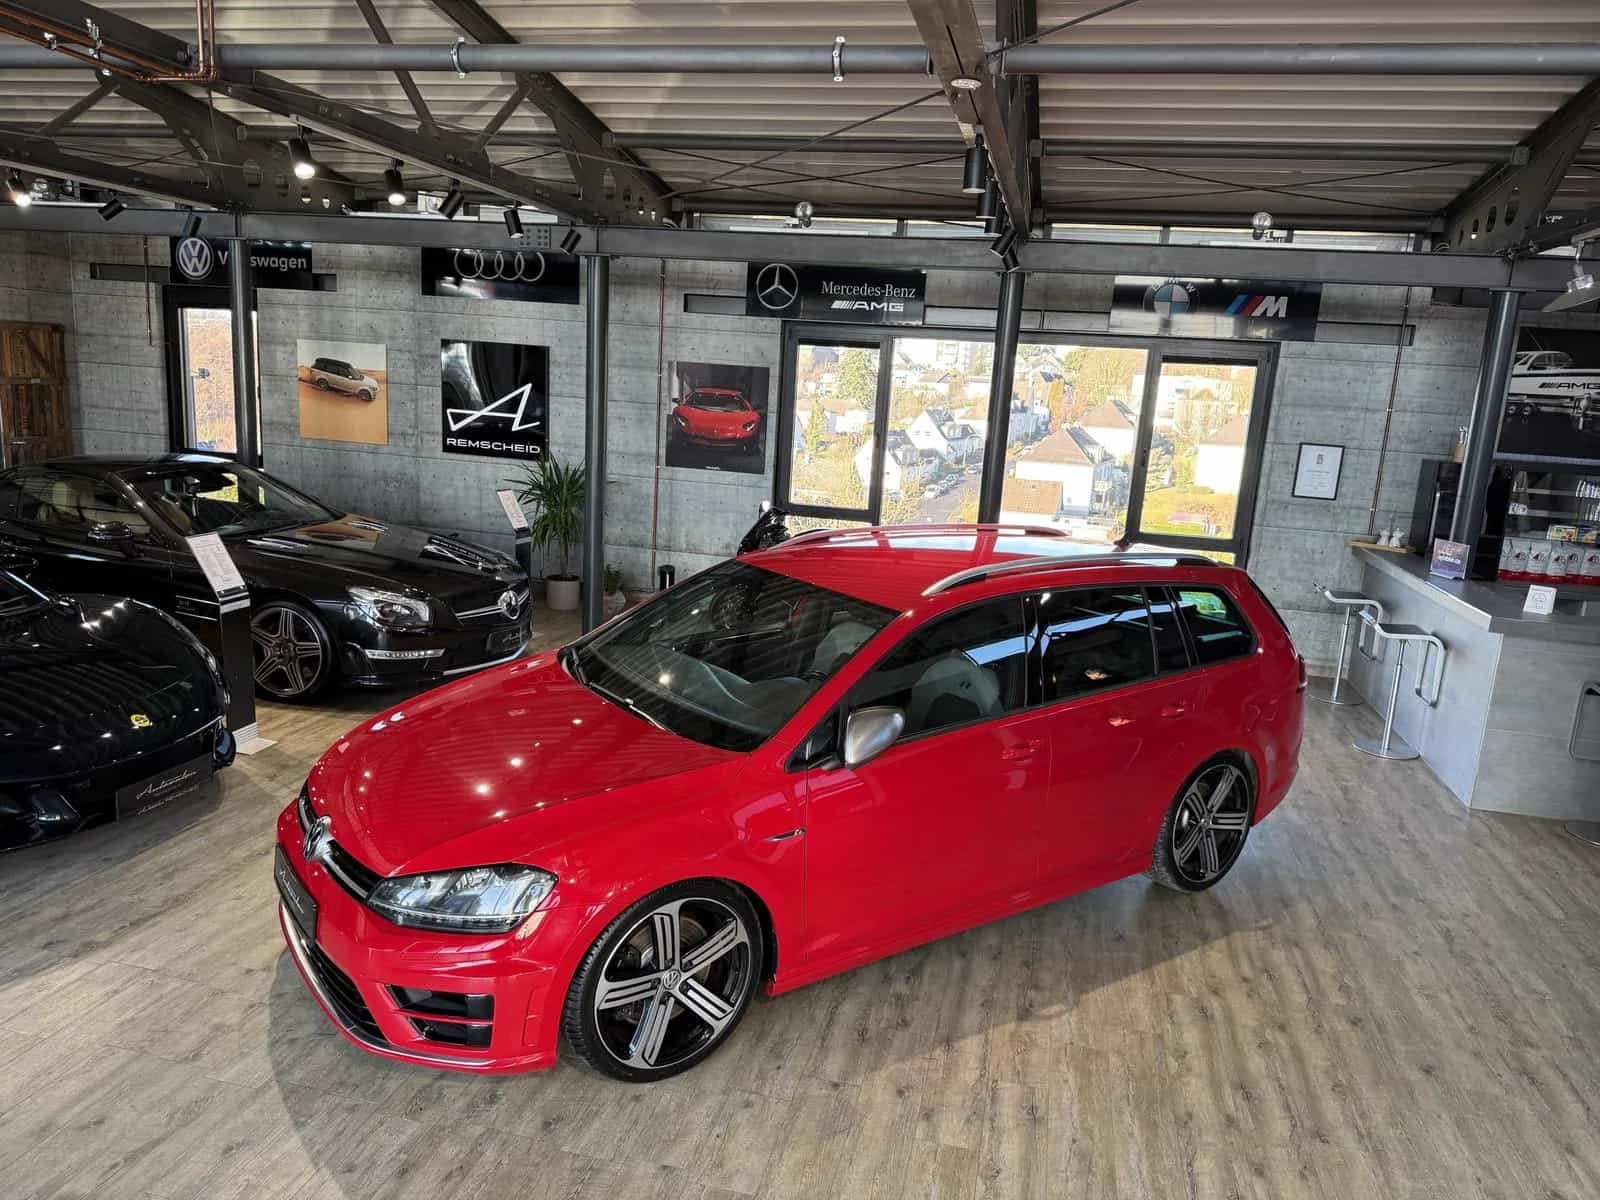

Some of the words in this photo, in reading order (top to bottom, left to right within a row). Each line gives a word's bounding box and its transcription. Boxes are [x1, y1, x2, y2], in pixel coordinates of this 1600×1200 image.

[217, 250, 307, 271] Vswagen
[821, 281, 917, 298] Mercedes-Benz
[852, 301, 905, 312] AMG
[446, 438, 541, 454] REMSCHEID
